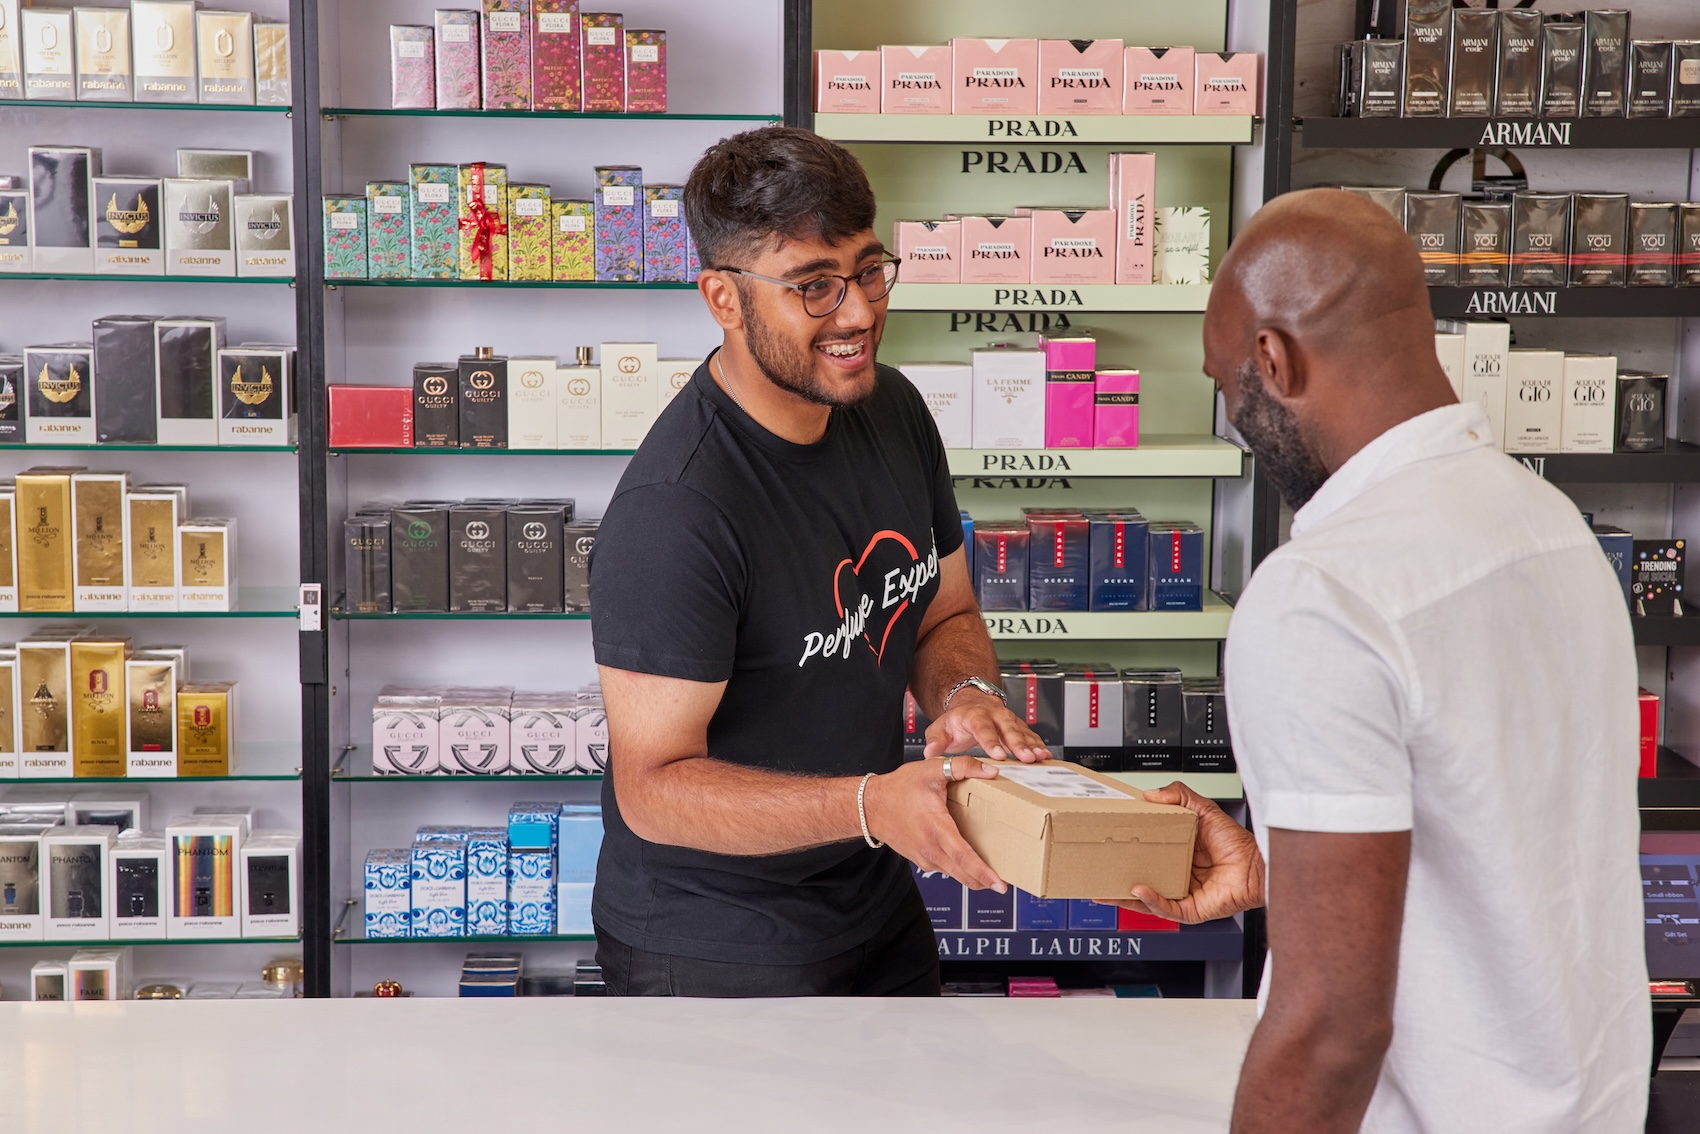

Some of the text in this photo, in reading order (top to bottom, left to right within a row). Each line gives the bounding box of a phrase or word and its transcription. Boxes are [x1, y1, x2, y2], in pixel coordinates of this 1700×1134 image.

[1413, 28, 1442, 36] ARMANI
[1461, 39, 1488, 47] ARMANI
[1594, 38, 1621, 46] ARMANI
[1465, 45, 1483, 53] code
[1550, 49, 1575, 57] ARMANI
[1598, 45, 1616, 53] code
[1370, 61, 1395, 69] ARMANI
[1638, 61, 1663, 69] ARMANI
[28, 80, 71, 89] rabanne
[82, 80, 125, 90] rabanne
[828, 81, 871, 91] PRADA
[892, 79, 942, 90] PRADA
[965, 76, 1026, 89] PRADA
[1050, 77, 1111, 89] PRADA
[1133, 80, 1183, 91] PRADA
[143, 83, 186, 92] rabanne
[204, 83, 246, 93] rabanne
[1203, 83, 1247, 93] PRADA
[988, 121, 1079, 137] PRADA
[1479, 122, 1572, 145] ARMANI
[961, 151, 1088, 173] PRADA
[420, 187, 448, 195] GUCCI
[108, 210, 149, 221] INVICTUS
[179, 212, 220, 221] INVICTUS
[1135, 194, 1145, 246] PRADA
[248, 222, 281, 230] INVICTUS
[1420, 236, 1445, 247] YOU
[1473, 236, 1498, 247] YOU
[1528, 236, 1553, 247] YOU
[1587, 237, 1611, 248] YOU
[1641, 236, 1665, 247] YOU
[1691, 237, 1700, 247] YO
[972, 250, 1021, 259] PRADA
[1044, 246, 1103, 257] PRADA
[107, 255, 150, 264] rabanne
[179, 256, 221, 265] rabanne
[245, 257, 287, 265] rabanne
[910, 252, 952, 261] PRADA
[994, 289, 1084, 305] PRADA
[1465, 291, 1557, 313] ARMANI
[39, 381, 80, 390] INVICTUS
[232, 383, 272, 393] INVICTUS
[418, 396, 454, 404] GUCCI
[39, 424, 81, 433] rabanne
[232, 425, 273, 434] rabanne
[983, 455, 1071, 470] PRADA
[351, 538, 385, 546] GUCCI
[402, 540, 438, 548] GUCCI
[460, 541, 496, 549] GUCCI
[518, 541, 553, 550] GUCCI
[1640, 561, 1677, 572] TRENDING
[80, 592, 122, 602] rabanne
[132, 593, 174, 601] rabanne
[182, 592, 224, 601] rabanne
[984, 618, 1069, 634] PRADA
[25, 759, 67, 767] rabanne
[131, 758, 172, 767] rabanne
[177, 847, 229, 857] PHANTOM
[938, 938, 1142, 955] ALPH LAUREN
[80, 989, 104, 998] FAME
